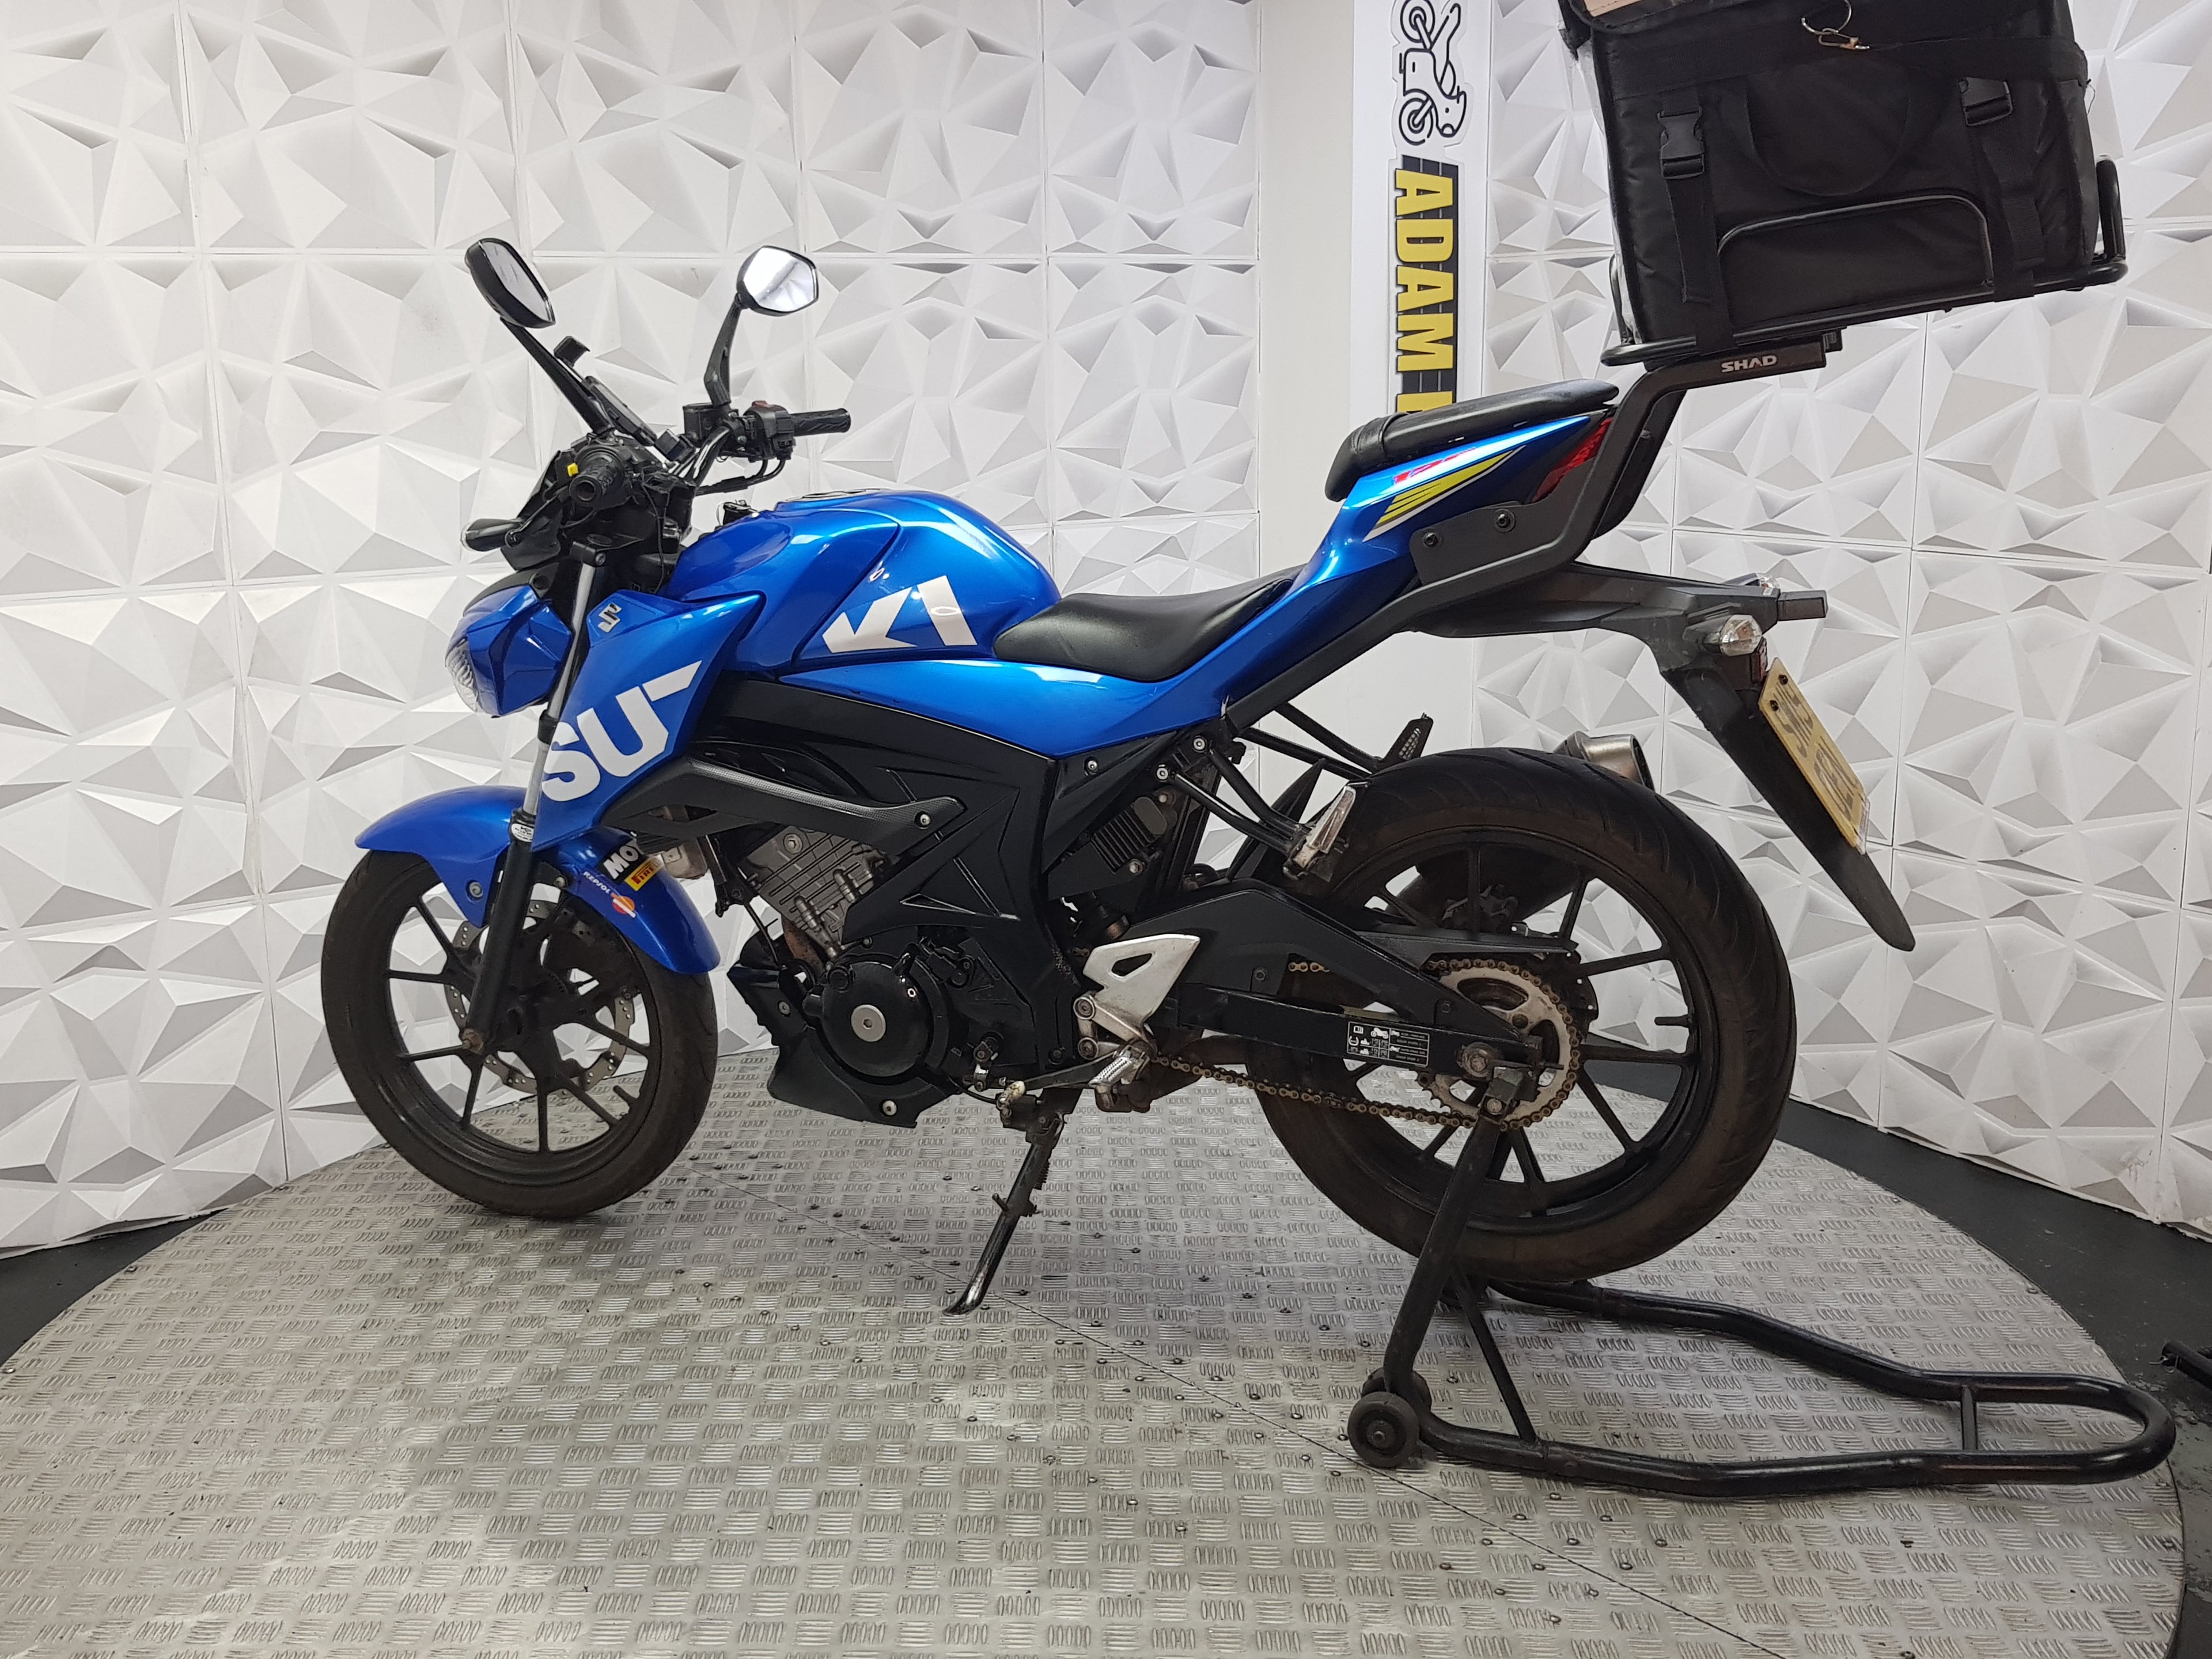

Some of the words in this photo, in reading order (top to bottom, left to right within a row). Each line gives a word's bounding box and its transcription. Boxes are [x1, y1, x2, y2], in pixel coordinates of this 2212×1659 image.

[1396, 169, 1454, 372] ADAM
[1721, 355, 1778, 373] SHAD
[584, 872, 611, 894] REPSOL
